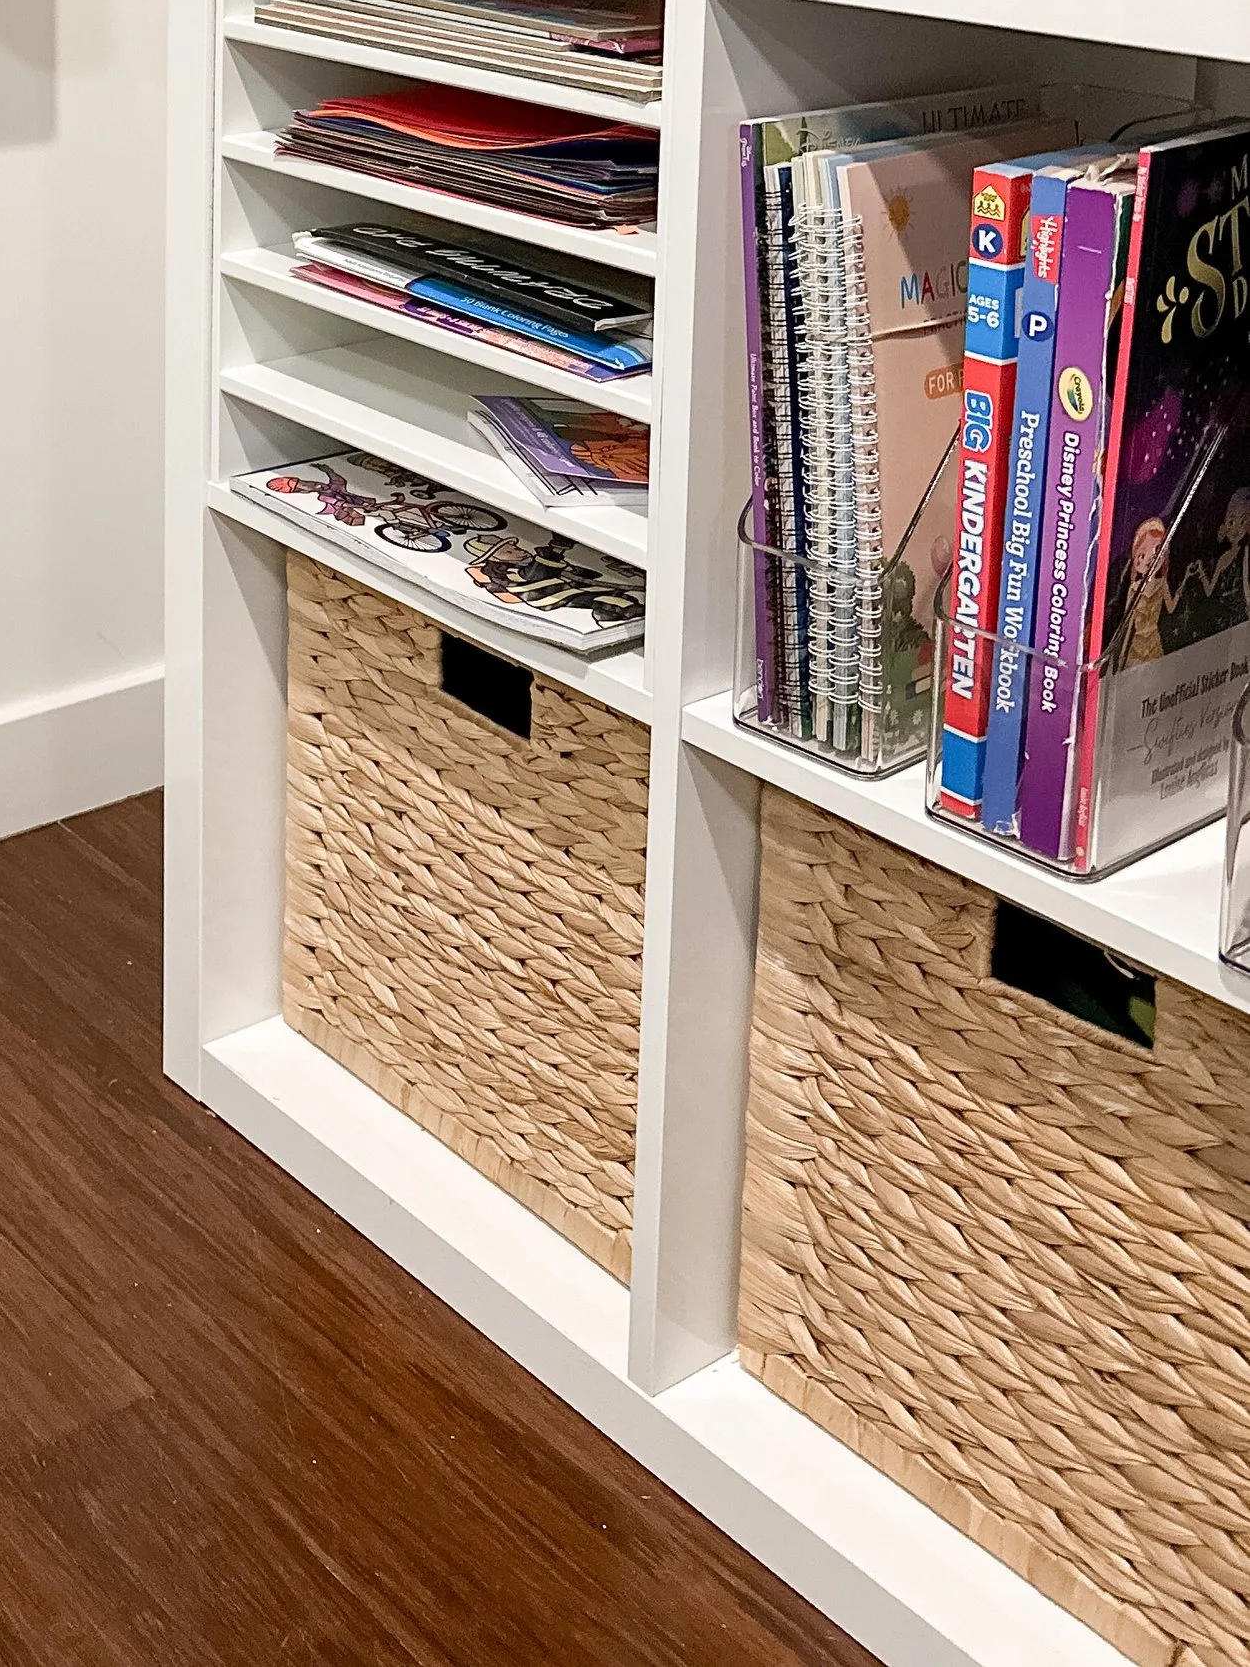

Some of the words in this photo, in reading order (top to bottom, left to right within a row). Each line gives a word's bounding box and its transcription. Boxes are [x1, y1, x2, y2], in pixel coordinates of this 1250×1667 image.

[978, 230, 996, 253] K
[1032, 216, 1058, 279] Highlights
[473, 298, 501, 316] Blank
[501, 309, 544, 330] Coloring
[541, 321, 569, 338] Pages
[967, 308, 1000, 329] 5-6
[969, 294, 1000, 310] AGES
[1028, 314, 1048, 337] P
[927, 372, 955, 395] FOR
[1073, 376, 1085, 412] Crayola
[963, 389, 993, 453] BIG
[1013, 410, 1040, 518] Preschool
[1056, 431, 1081, 498] Disney
[1005, 519, 1031, 558] Big
[1052, 499, 1075, 581] Princess
[1006, 559, 1028, 602] Fun
[1041, 665, 1059, 713] Book
[1141, 697, 1158, 719] The
[1159, 679, 1199, 712] Unofficial
[1200, 668, 1229, 695] Sticker
